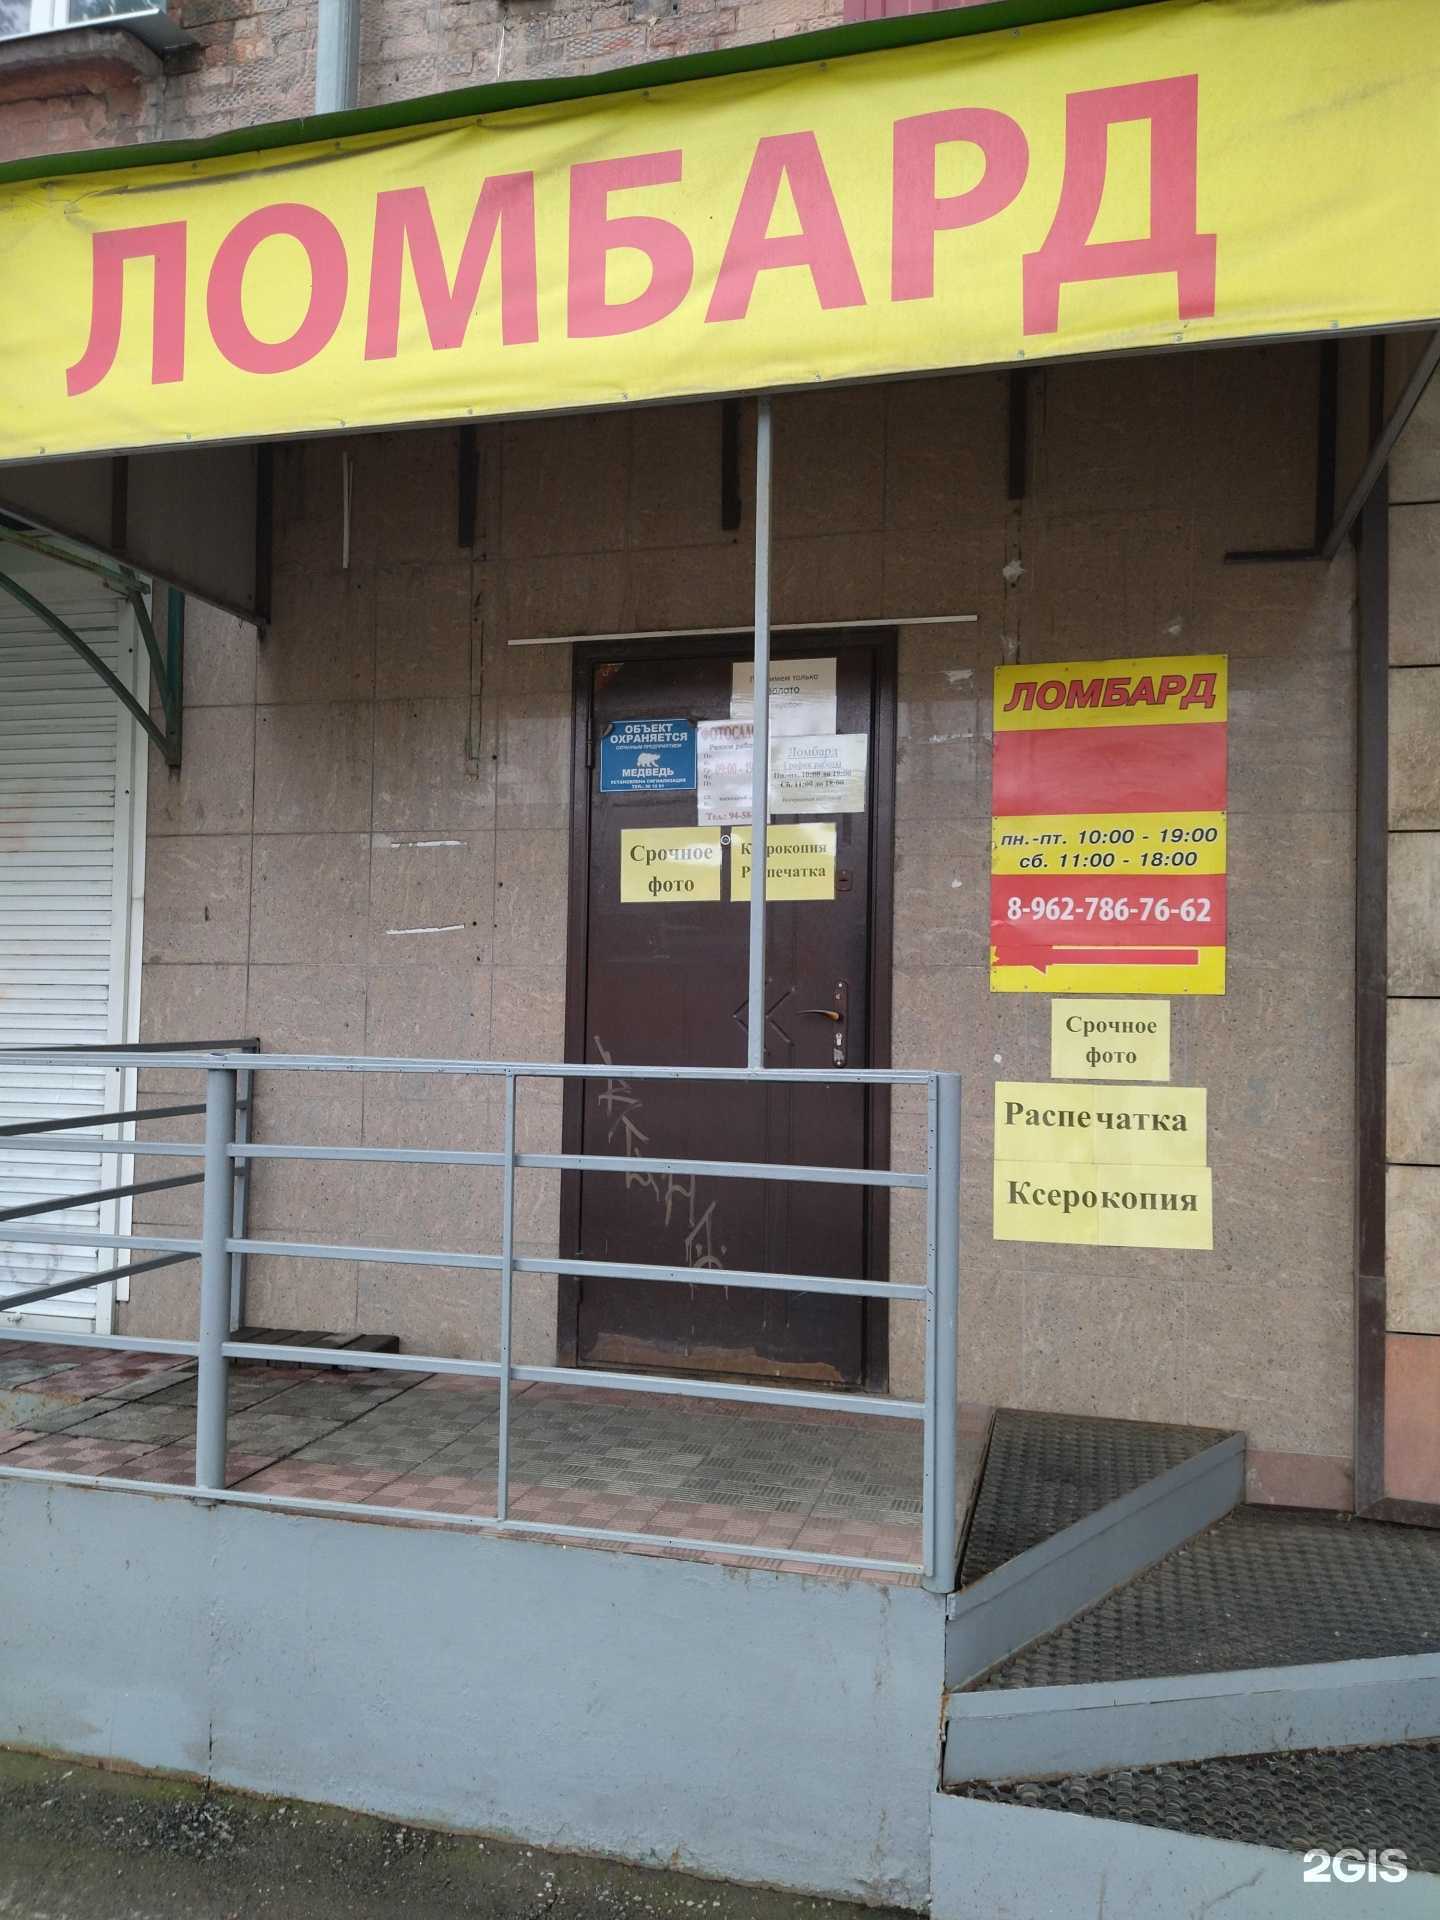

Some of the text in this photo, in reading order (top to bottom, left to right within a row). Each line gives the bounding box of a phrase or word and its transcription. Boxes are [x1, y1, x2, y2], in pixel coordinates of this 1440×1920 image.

[66, 74, 1217, 398] ЛОМБАРД
[1003, 673, 1218, 712] ЛОМБАРД
[610, 732, 688, 744] ОХРАНЯЕТСЯ
[624, 723, 673, 733] ОБЪЕКТ
[621, 767, 674, 778] МЕДВЕДЬ
[1078, 829, 1135, 845] 10:00
[1160, 827, 1218, 843] 19:00
[630, 844, 713, 866] Срочное
[741, 842, 827, 858] Крокопия
[1019, 853, 1048, 868] сб.
[1059, 852, 1115, 868] 11:00
[1140, 851, 1198, 867] 18:00
[741, 865, 826, 879] Рпечатка
[648, 876, 695, 896] фото
[1007, 896, 1212, 922] 8-962-786-76-62
[1065, 1015, 1157, 1037] Срочное
[1085, 1046, 1137, 1068] фото
[1004, 1101, 1188, 1132] Распечатка
[1007, 1180, 1199, 1213] Ксерокопия
